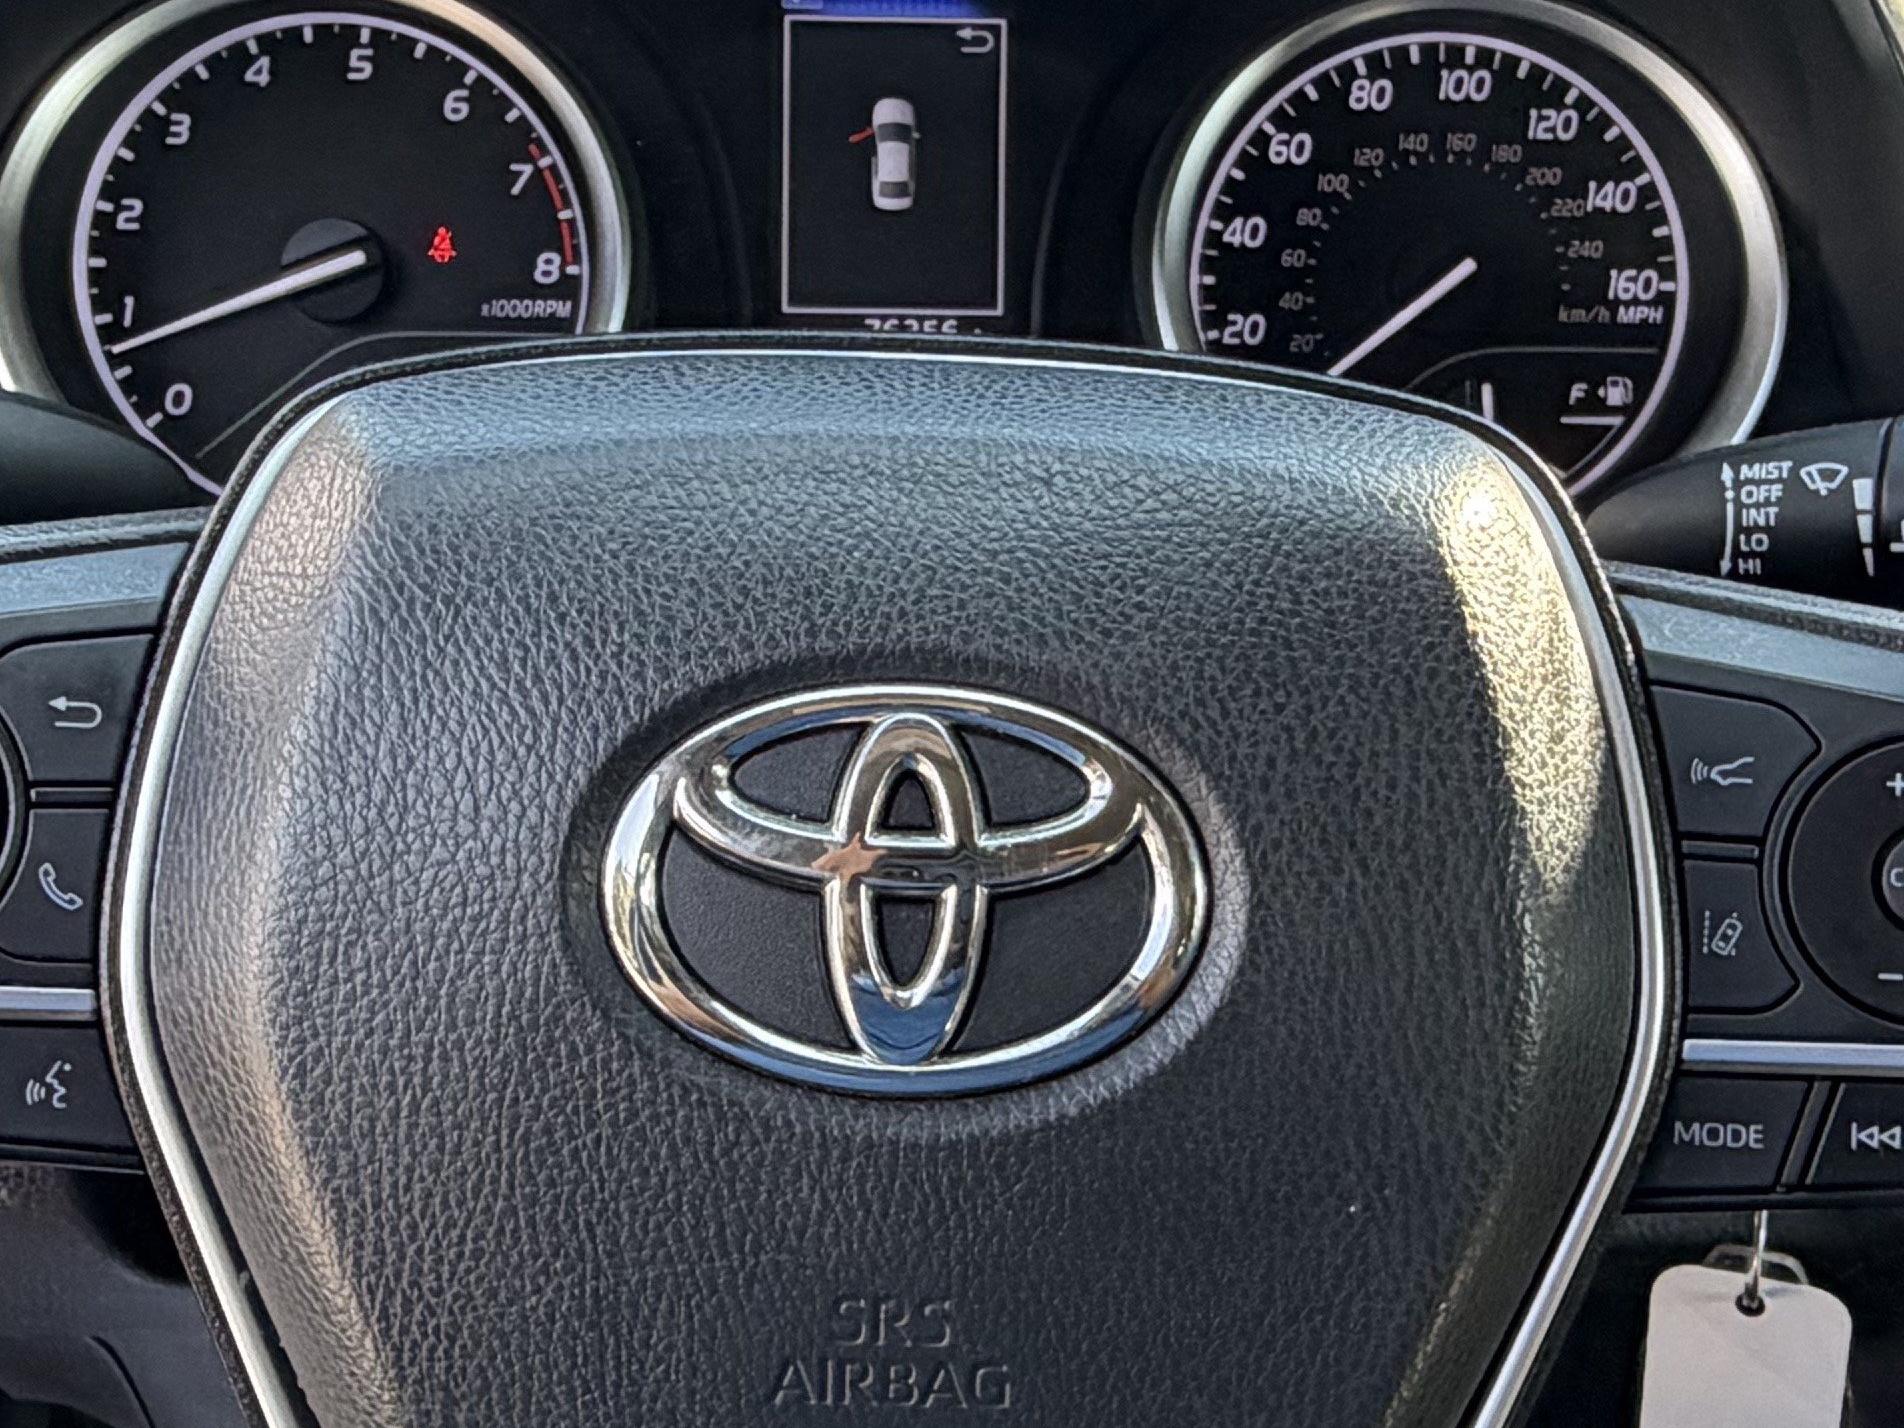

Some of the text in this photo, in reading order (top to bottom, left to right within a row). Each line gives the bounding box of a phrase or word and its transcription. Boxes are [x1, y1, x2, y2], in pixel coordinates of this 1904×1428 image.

[245, 56, 270, 87] 4
[347, 48, 373, 80] 5
[1349, 79, 1393, 111] 80
[1439, 69, 1491, 101] 100
[444, 89, 469, 121] 6
[165, 113, 191, 144] 3
[1528, 108, 1579, 141] 120
[1267, 132, 1312, 165] 60
[1399, 133, 1429, 152] 140
[1447, 133, 1477, 152] 160
[1492, 144, 1522, 163] 180
[1354, 148, 1384, 167] 120
[509, 164, 533, 195] 7
[1317, 173, 1351, 194] 100
[1525, 167, 1562, 185] 200
[1551, 198, 1585, 217] 220
[1587, 179, 1638, 213] 140
[116, 199, 143, 230] 2
[1296, 207, 1321, 226] 80
[1223, 217, 1267, 248] 40
[1281, 249, 1306, 267] 60
[1567, 240, 1603, 258] 240
[534, 252, 560, 284] 8
[1608, 269, 1658, 300] 160
[123, 296, 134, 327] 1
[1279, 292, 1304, 310] 40
[1559, 305, 1663, 323] km/h MPH
[1223, 313, 1266, 345] 20
[1289, 334, 1313, 353] 20
[165, 383, 193, 415] 0
[1569, 383, 1587, 405] F
[1740, 461, 1792, 480] MIST
[1741, 484, 1783, 503] OFF
[1742, 506, 1779, 526] INT
[1739, 533, 1769, 551] LO
[1738, 558, 1761, 574] HI
[1674, 1121, 1764, 1149] MODE
[834, 1295, 954, 1348] SRS
[774, 1359, 1011, 1409] AIRBAG
